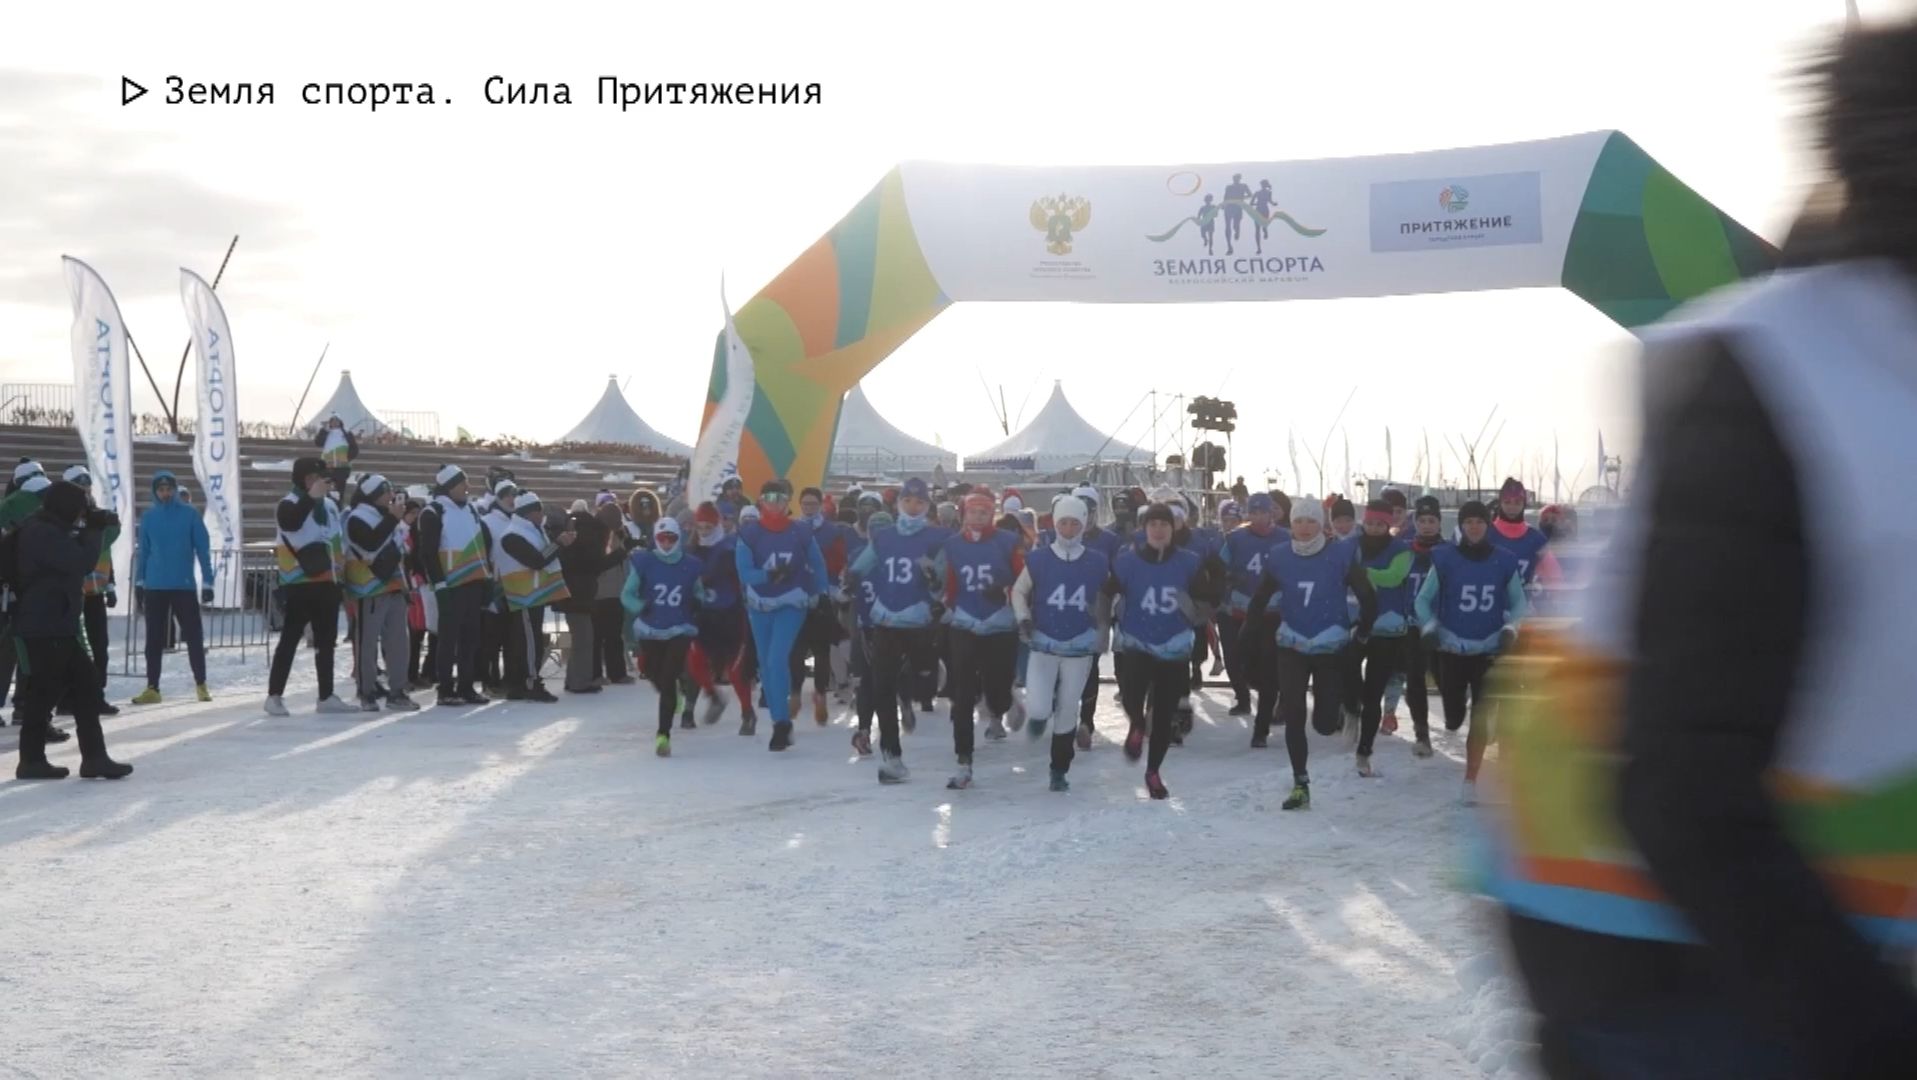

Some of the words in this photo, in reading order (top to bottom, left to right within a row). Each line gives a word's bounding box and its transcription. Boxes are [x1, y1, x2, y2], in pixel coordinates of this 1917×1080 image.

[1400, 215, 1512, 234] ПРИТЯЖЕНИЕ
[1153, 258, 1227, 276] ЗЕМЛЯ
[1233, 256, 1325, 274] СПОРТА
[884, 557, 912, 584] 13
[960, 564, 993, 591] 25
[653, 583, 682, 606] 26
[1047, 583, 1087, 611] 44
[1141, 586, 1177, 614] 45
[1298, 582, 1314, 607] 7
[1459, 584, 1495, 612] 55
